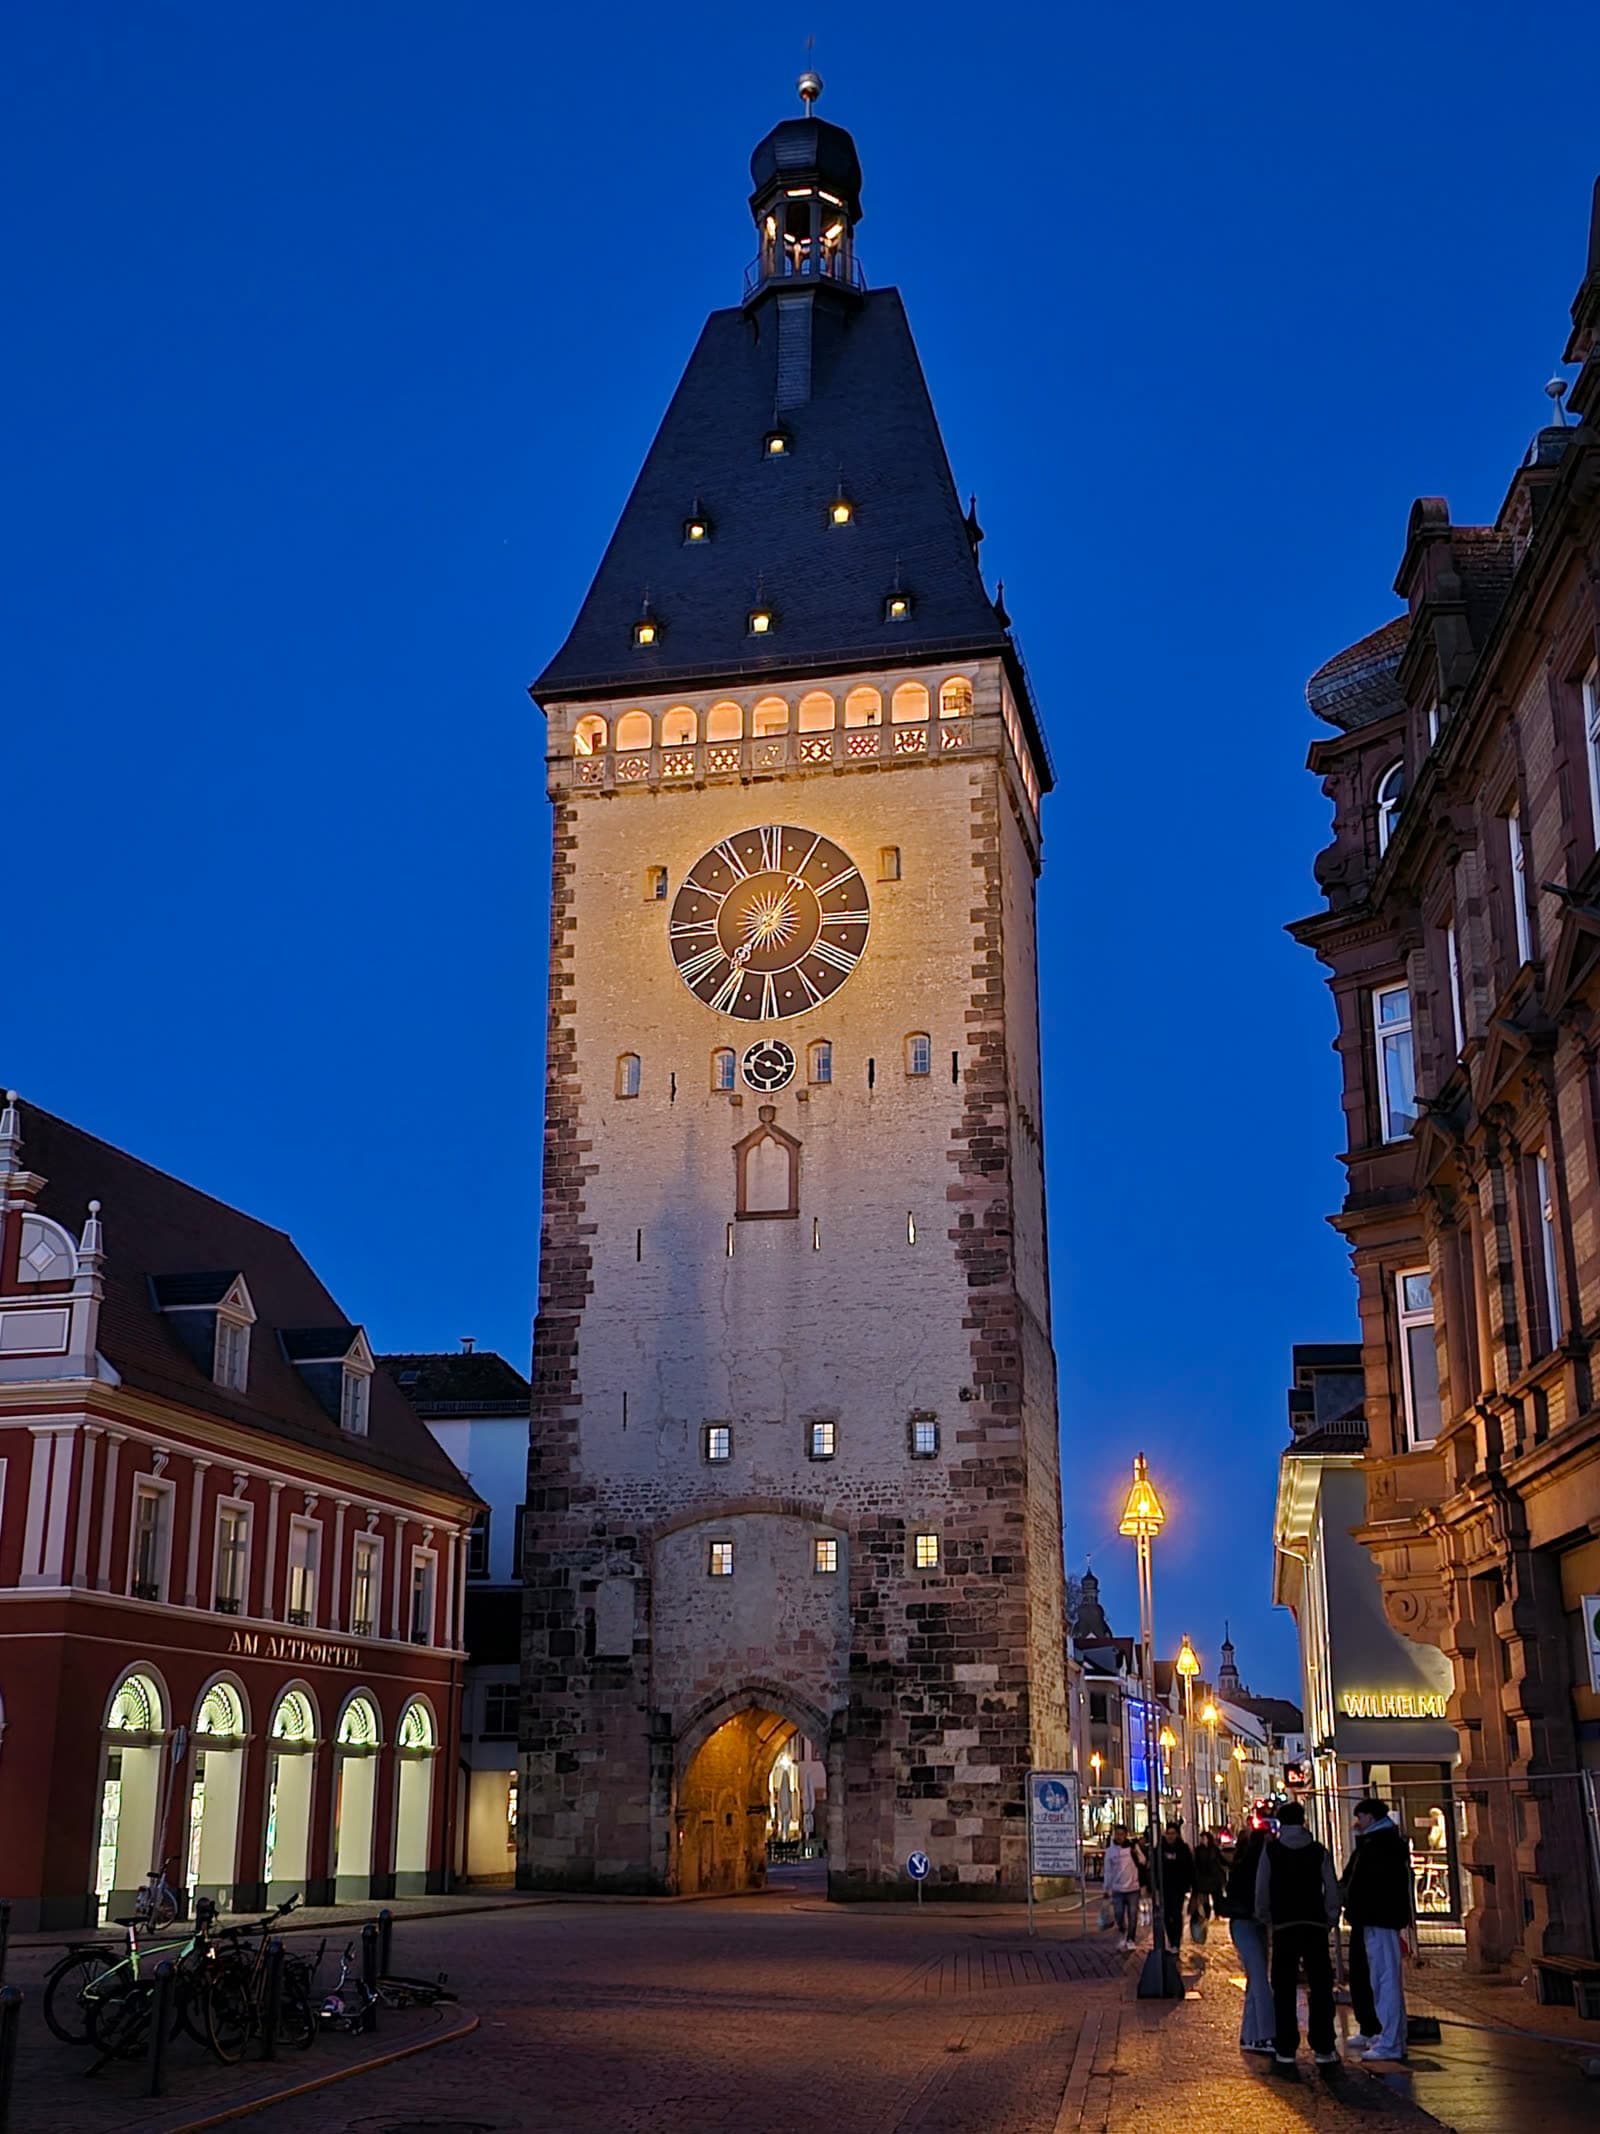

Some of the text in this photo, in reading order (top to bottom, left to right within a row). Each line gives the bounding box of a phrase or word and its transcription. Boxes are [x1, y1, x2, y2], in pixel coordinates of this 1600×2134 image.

[759, 827, 782, 871] XII
[228, 1631, 259, 1655] AM
[1343, 1694, 1446, 1718] WILHELMI
